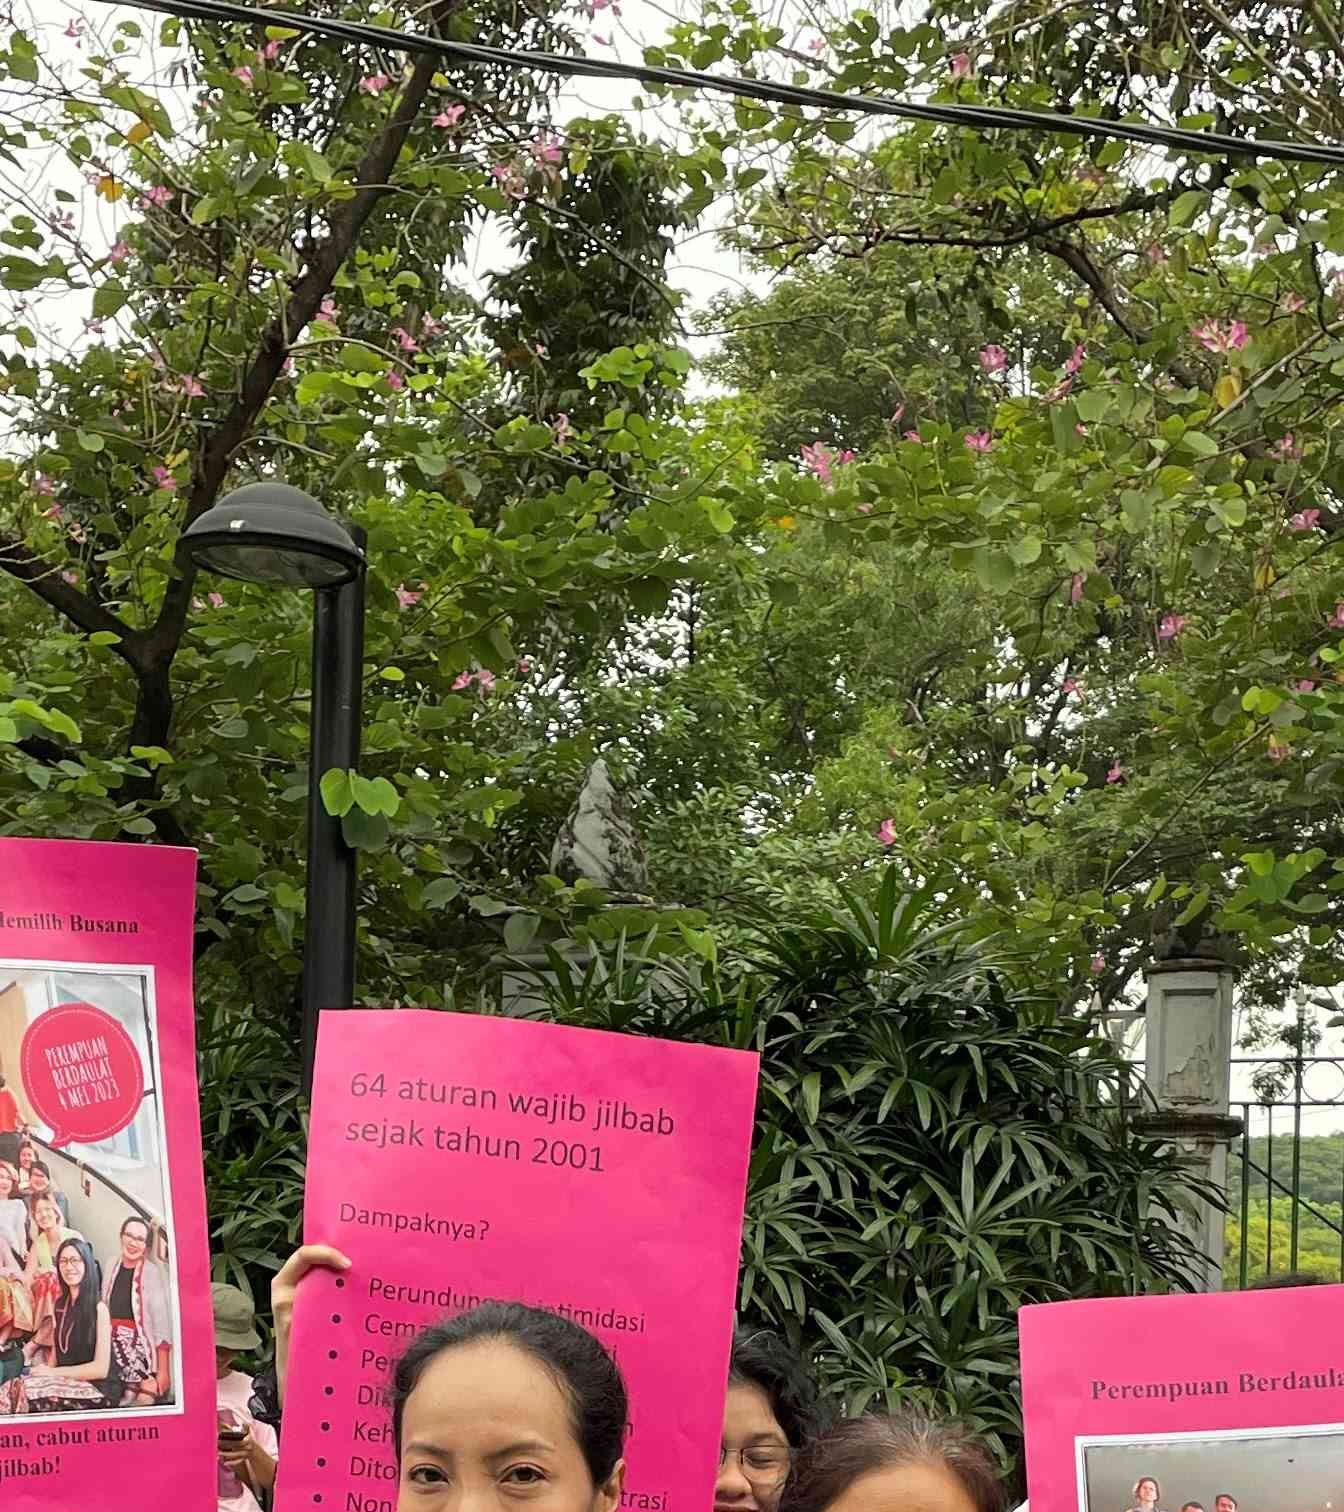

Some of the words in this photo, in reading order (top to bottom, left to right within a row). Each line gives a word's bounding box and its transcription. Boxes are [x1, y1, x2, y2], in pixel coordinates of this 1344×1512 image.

[70, 913, 140, 935] Busana
[349, 1072, 388, 1099] 64
[397, 1076, 498, 1112] aturan
[508, 1092, 586, 1126] wajib
[591, 1099, 676, 1137] jilbab
[345, 1119, 424, 1152] sejak
[433, 1125, 521, 1161] tahun
[531, 1137, 605, 1173] 2001
[338, 1202, 491, 1242] Dampaknya?
[1090, 1376, 1230, 1403] Perempuan
[35, 1426, 92, 1448] cabut
[95, 1423, 161, 1444] aturan
